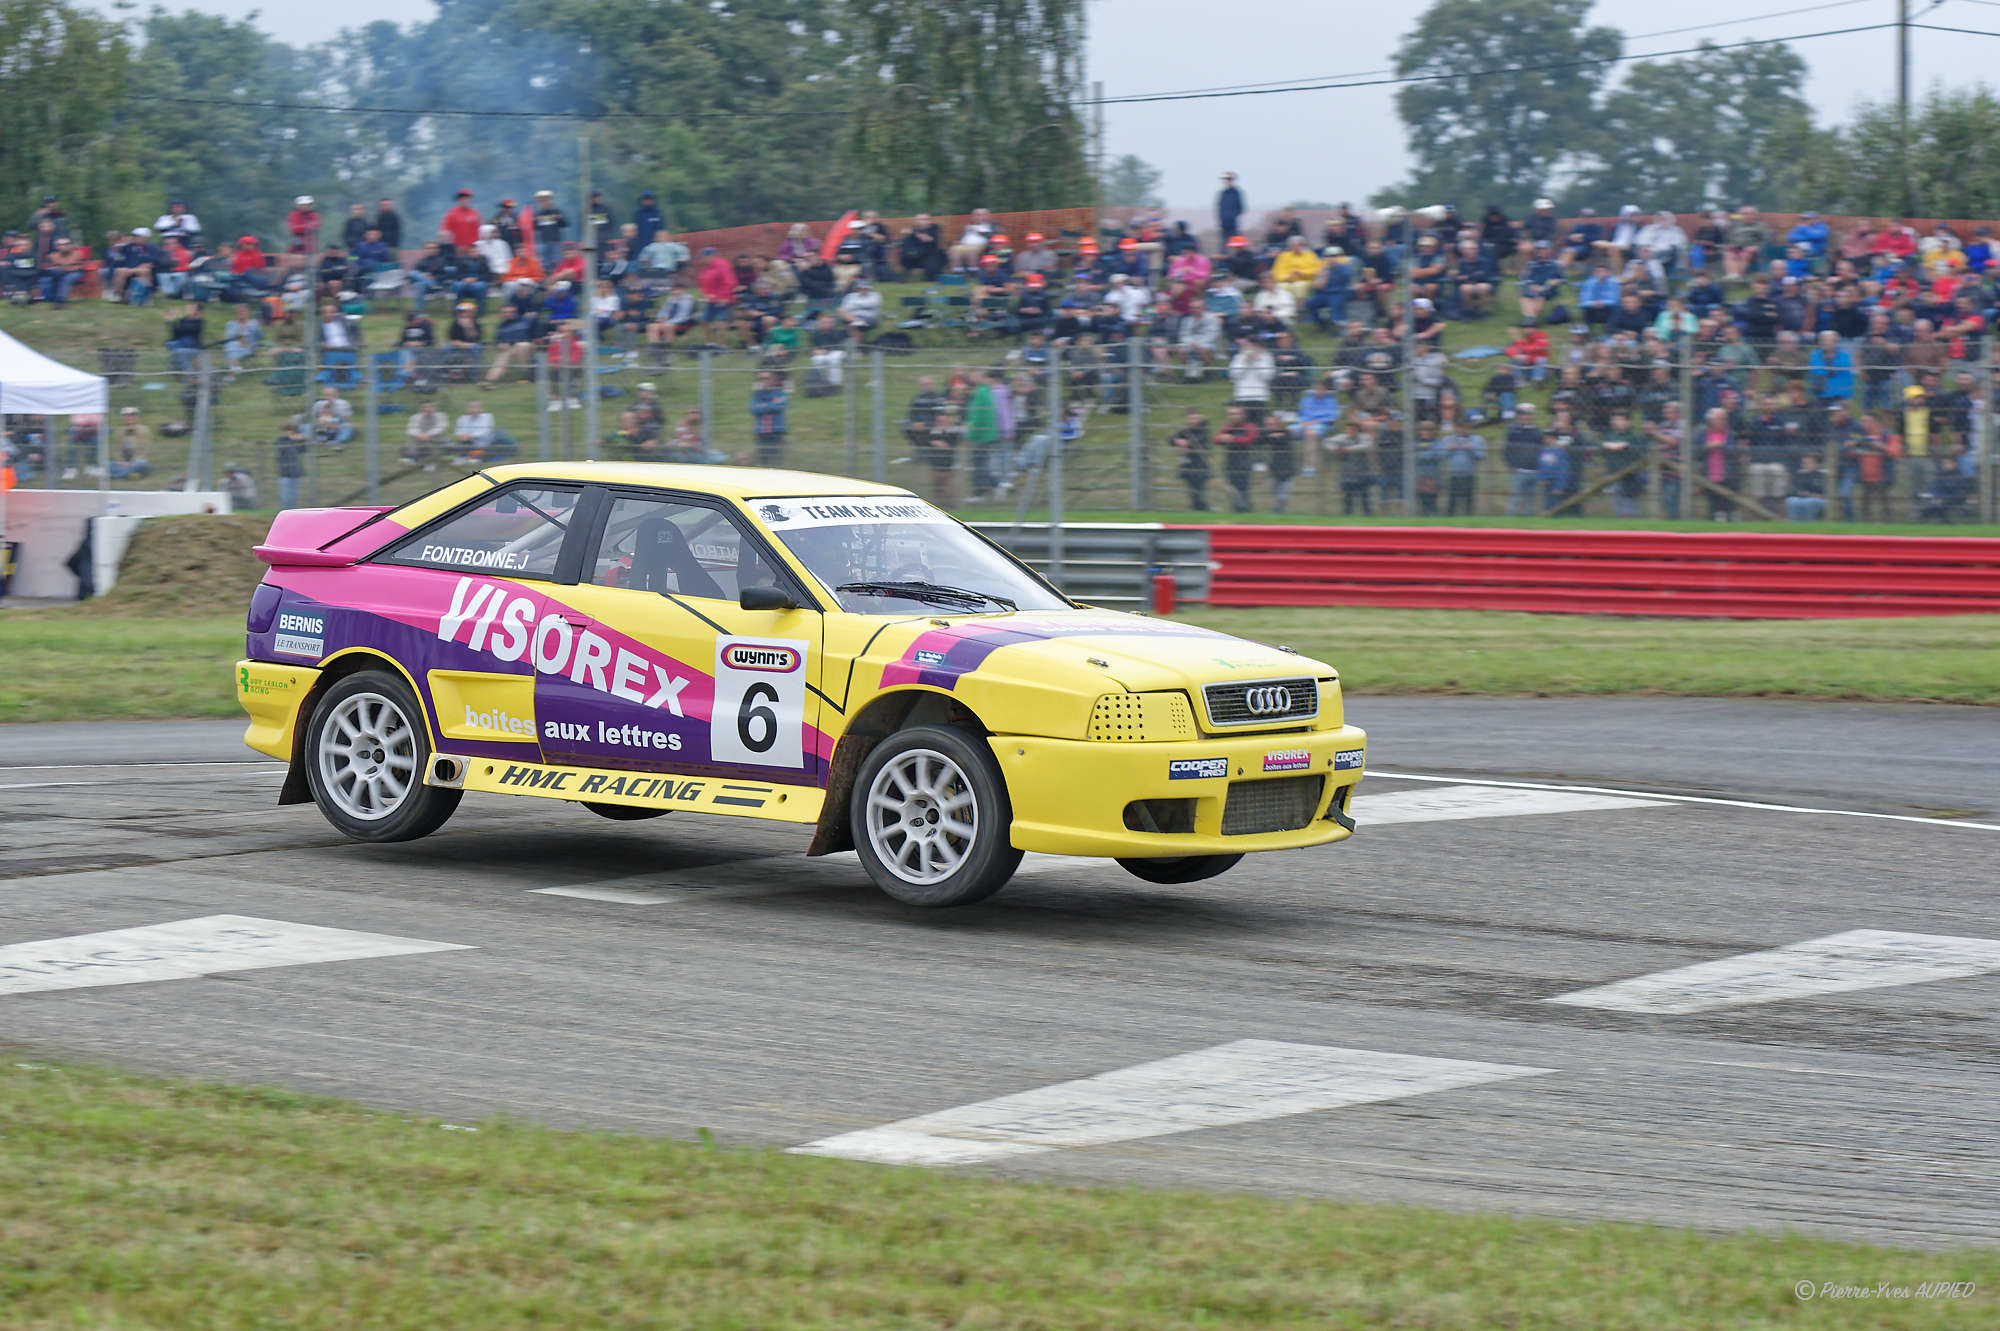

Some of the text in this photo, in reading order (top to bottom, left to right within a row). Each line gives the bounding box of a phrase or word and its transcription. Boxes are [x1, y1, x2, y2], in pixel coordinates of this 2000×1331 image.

[801, 505, 856, 519] TEAM
[421, 545, 529, 569] FONTBONNE.J
[280, 614, 323, 634] BERNIS
[277, 640, 321, 652] LE TRANSPORT
[438, 576, 690, 718] VISOREX
[738, 681, 780, 753] 6
[465, 705, 682, 751] boites aux lettres
[1267, 749, 1309, 761] VISOREX
[1336, 750, 1363, 762] COOPER
[1170, 758, 1227, 771] COOPER
[1199, 768, 1226, 777] TIRES
[498, 765, 706, 801] HMC RACING
